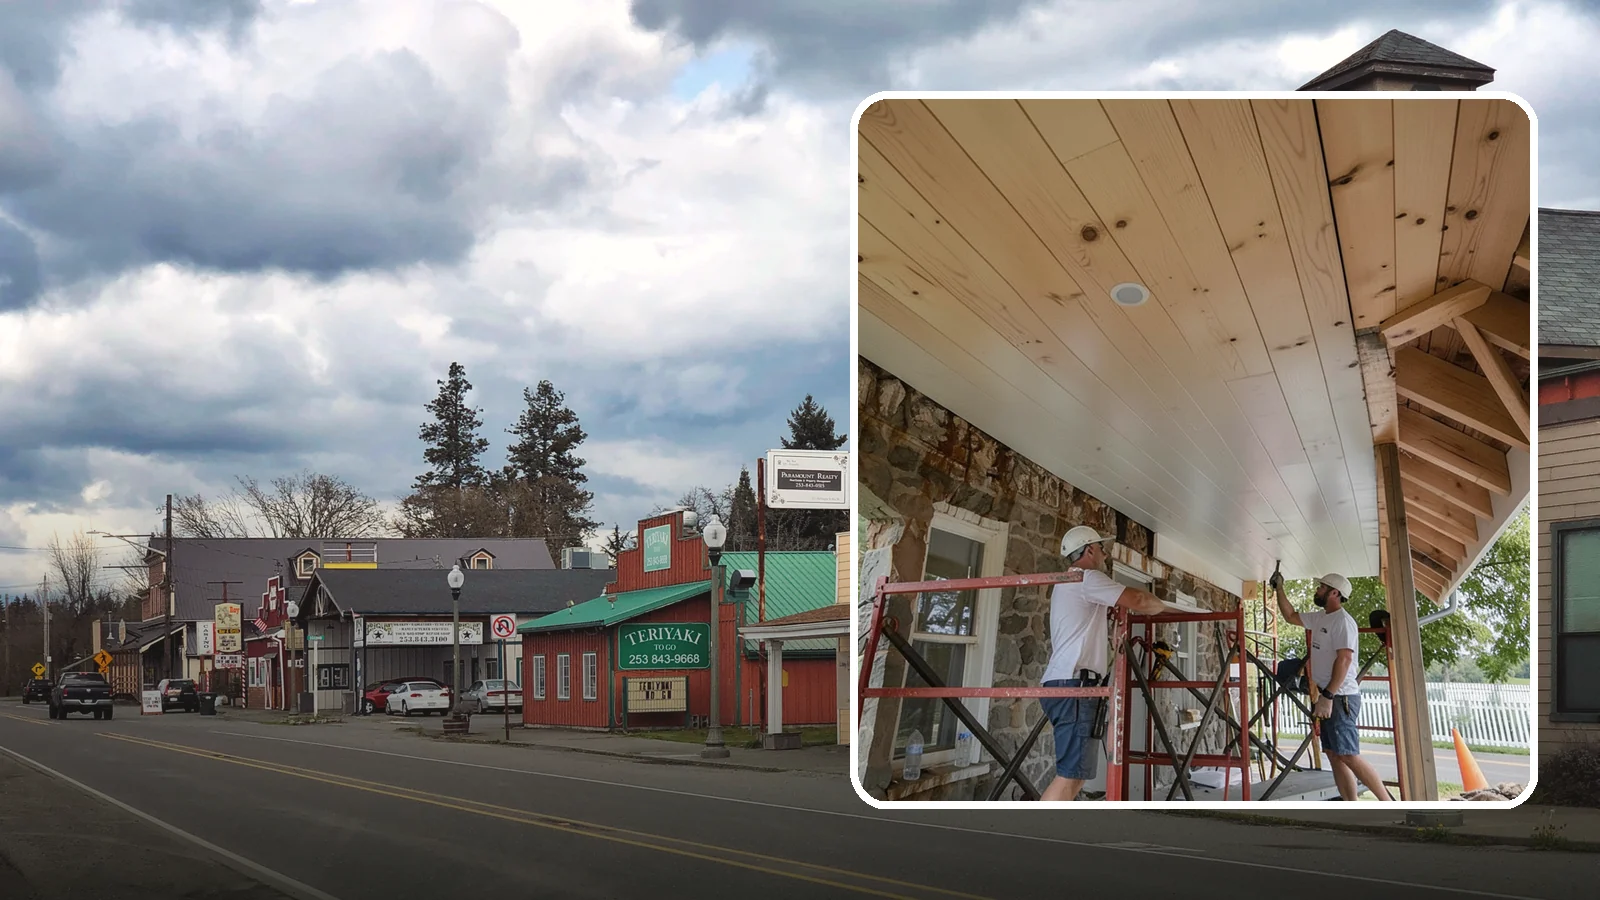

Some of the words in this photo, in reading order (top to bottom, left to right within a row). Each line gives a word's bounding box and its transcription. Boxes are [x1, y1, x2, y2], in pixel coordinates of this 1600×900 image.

[625, 627, 702, 646] TERIYAKI
[653, 643, 665, 651] TO
[665, 643, 677, 651] GO
[628, 654, 649, 665] 253
[651, 653, 700, 664] 843-9668
[639, 681, 673, 691] TERIYAKI
